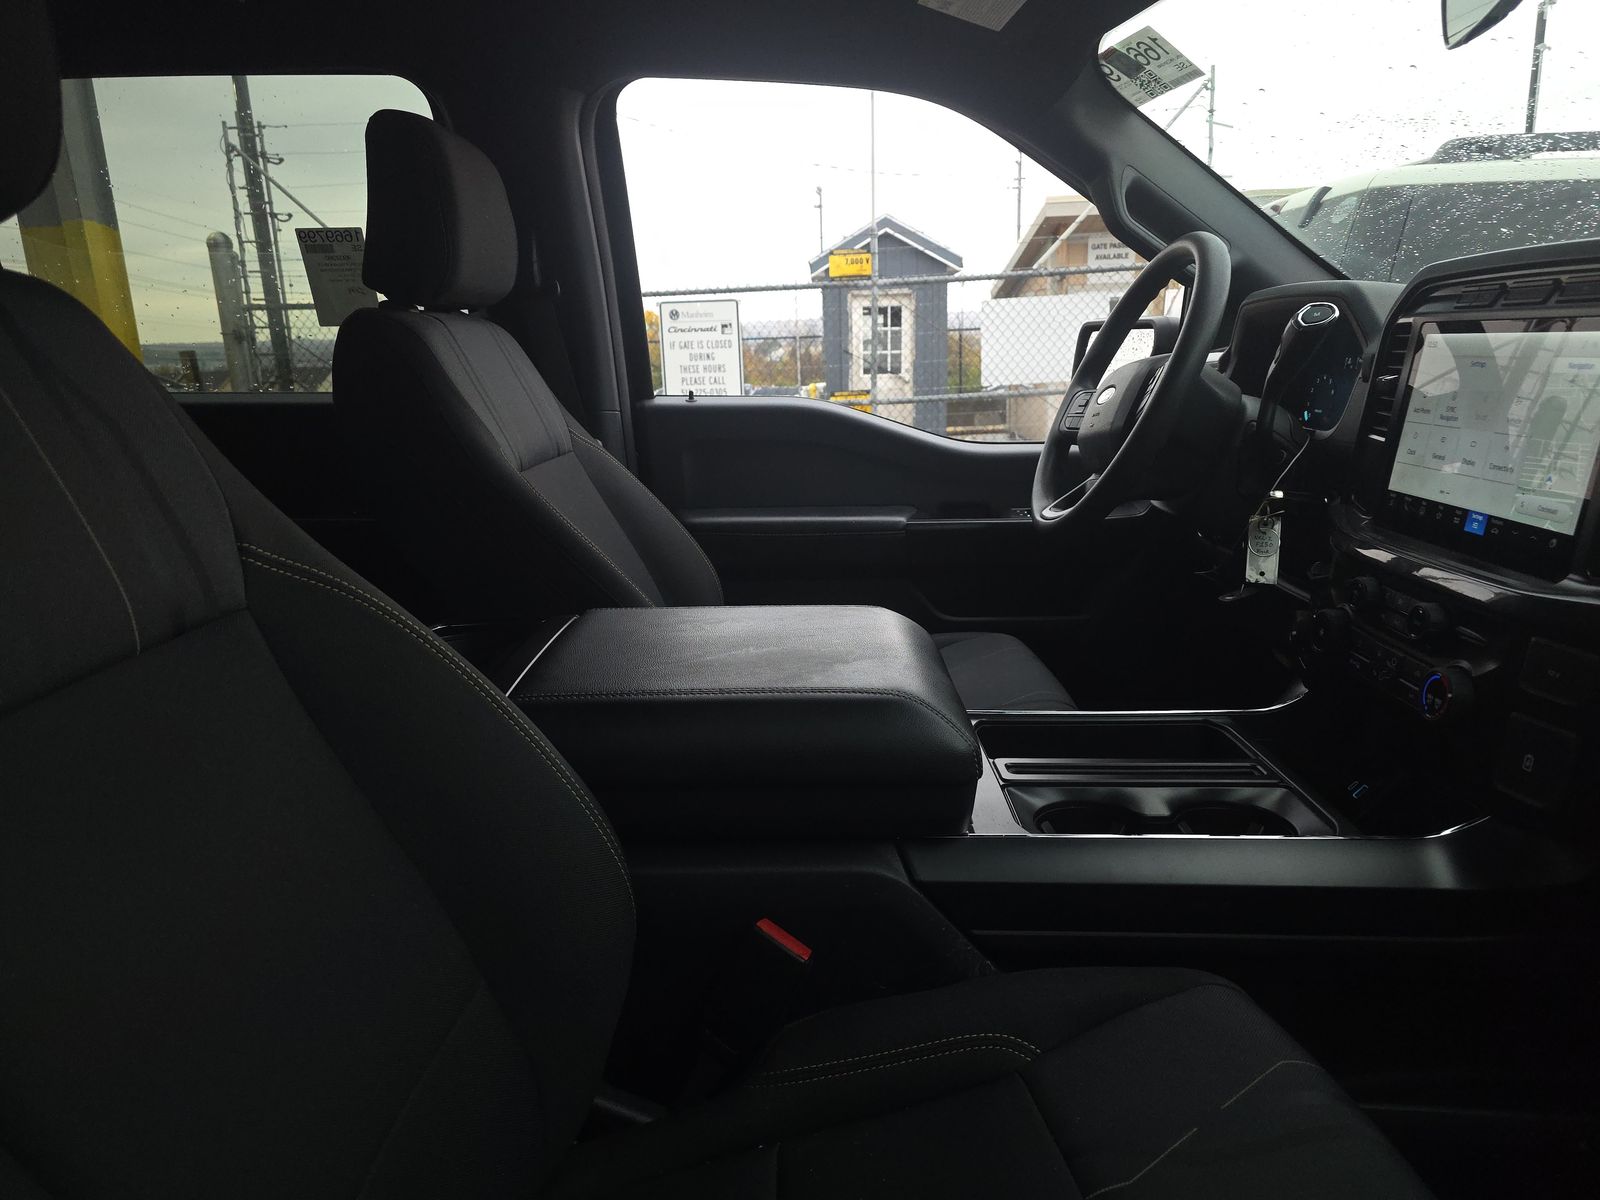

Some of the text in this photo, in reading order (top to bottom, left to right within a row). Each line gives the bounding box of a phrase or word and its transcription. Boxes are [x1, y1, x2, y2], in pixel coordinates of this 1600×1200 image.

[1095, 252, 1129, 261] AVAILABLE
[668, 325, 718, 334] Cincinnati
[669, 339, 733, 350] IF GATE IS CLOSED
[689, 352, 716, 362] DURING
[680, 364, 726, 374] THESE HOURS
[681, 376, 726, 386] PLEASE CALL
